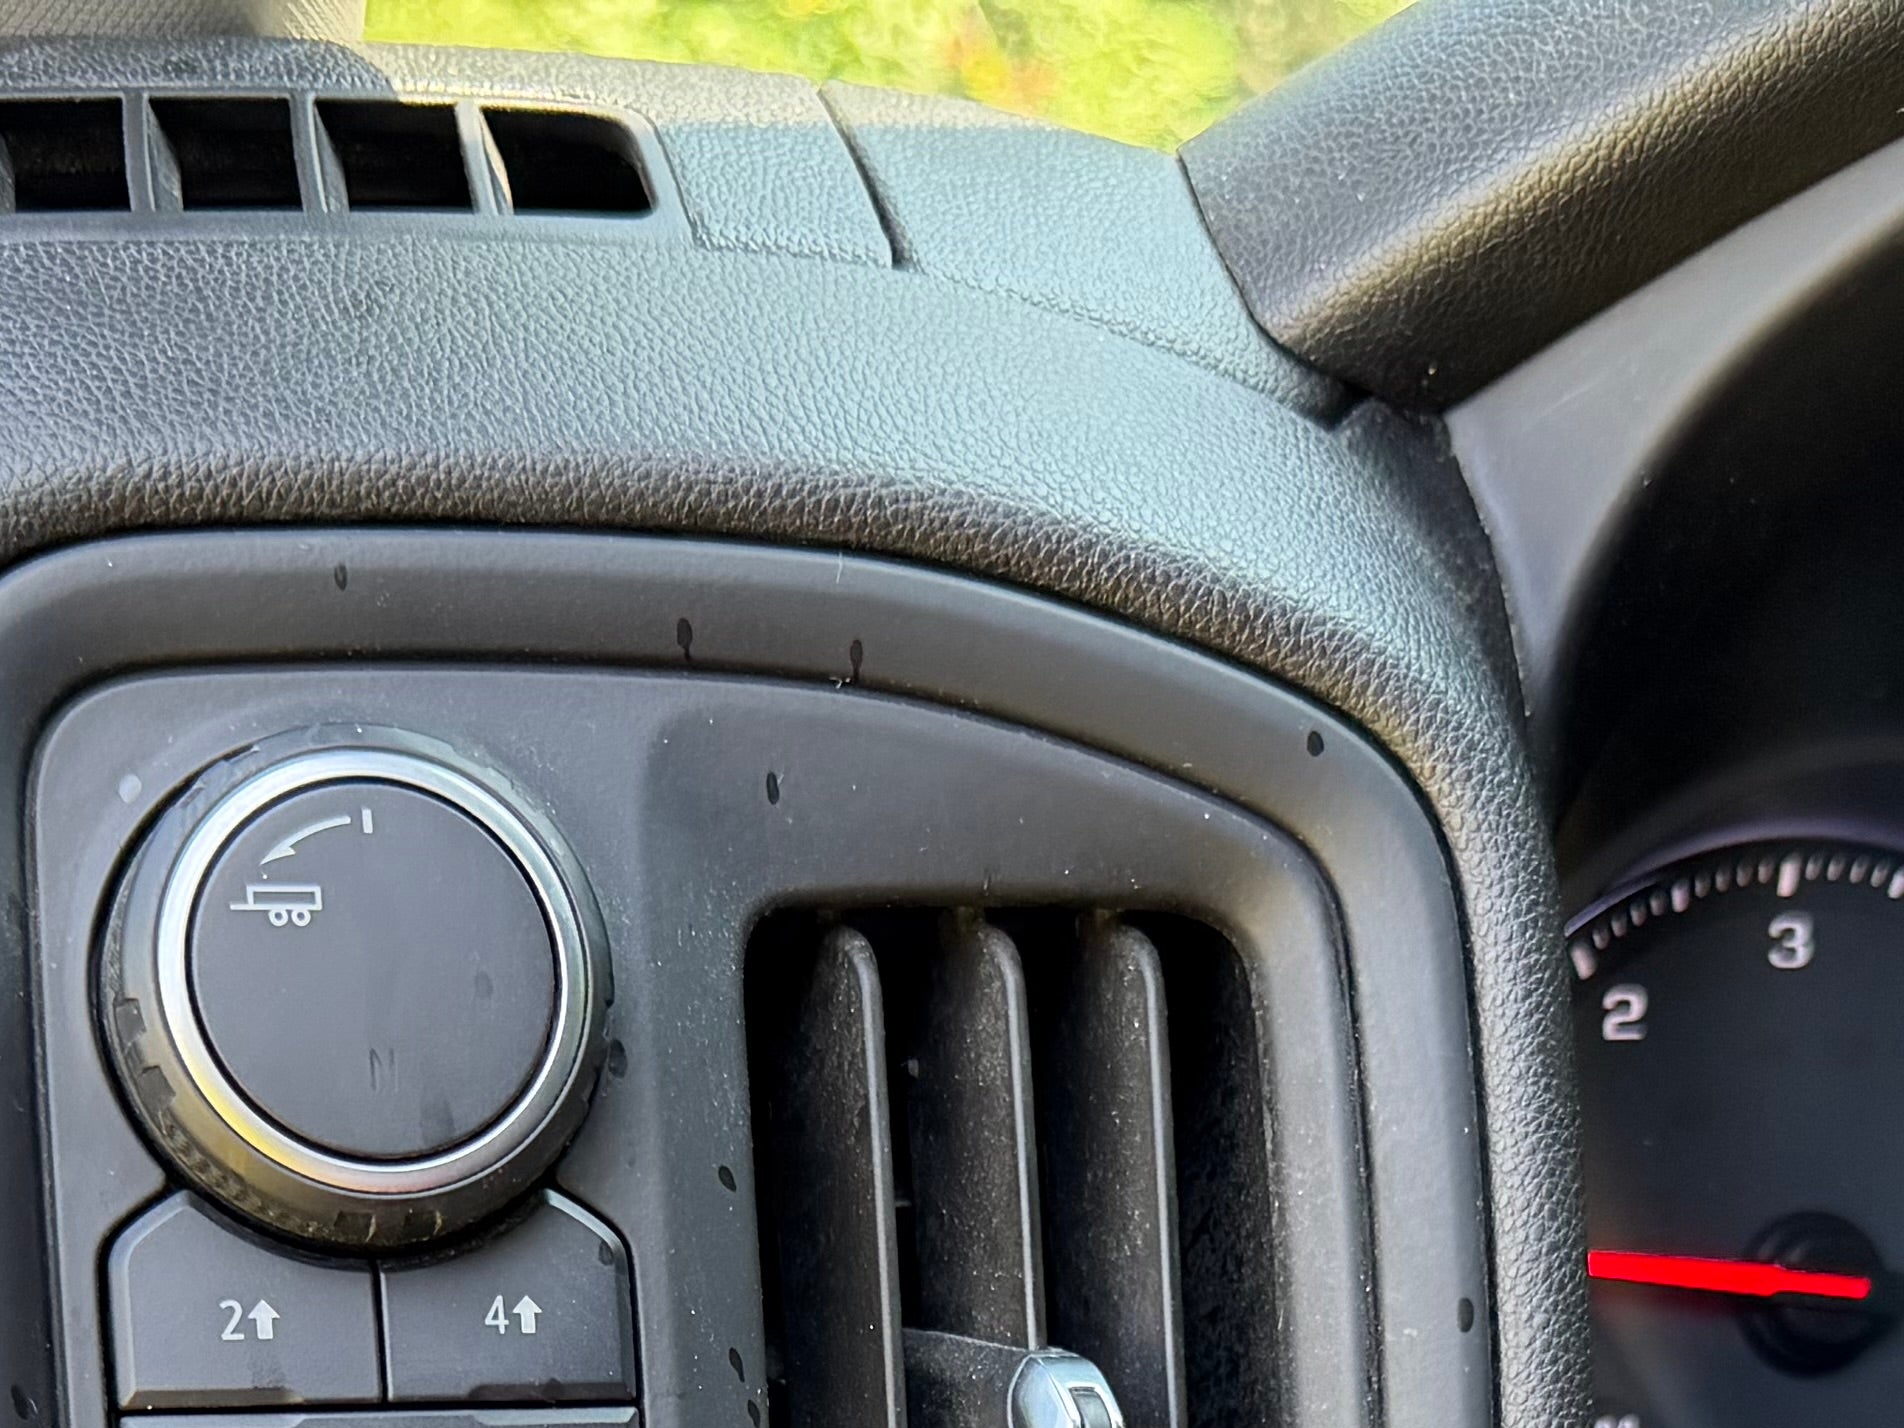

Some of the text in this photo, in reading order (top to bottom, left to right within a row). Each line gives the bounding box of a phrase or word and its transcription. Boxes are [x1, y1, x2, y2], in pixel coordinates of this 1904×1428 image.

[1767, 910, 1815, 969] 3
[1602, 983, 1648, 1041] 2
[218, 1298, 245, 1341] 2
[484, 1294, 510, 1335] 4
